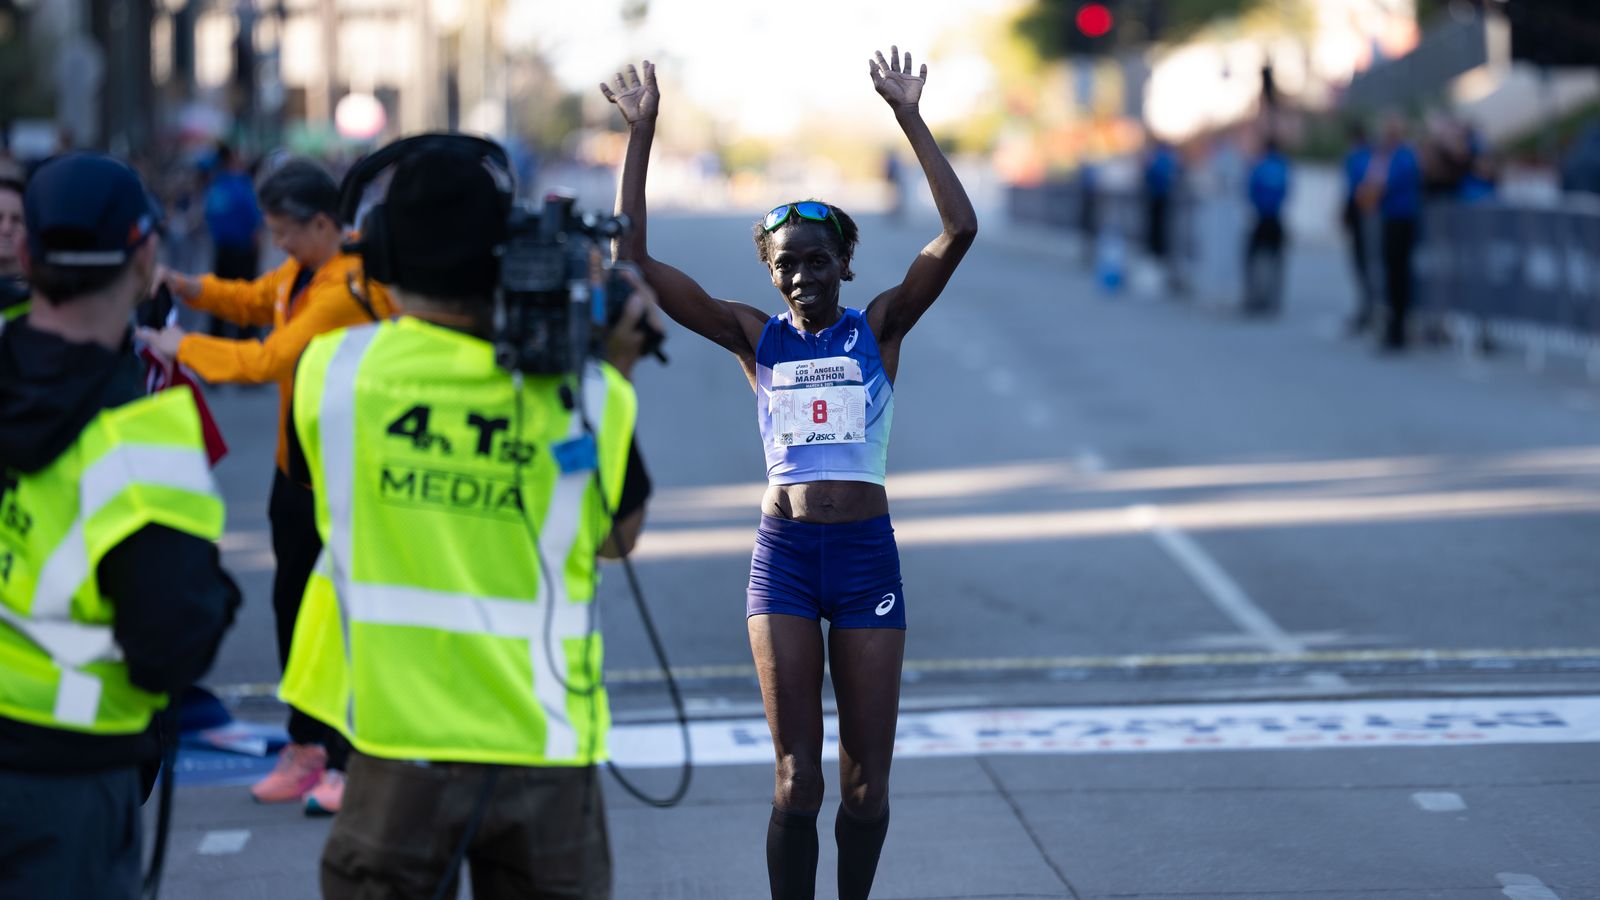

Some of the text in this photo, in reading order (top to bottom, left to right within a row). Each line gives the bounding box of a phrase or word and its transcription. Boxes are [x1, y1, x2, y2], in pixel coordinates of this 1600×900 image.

[814, 366, 845, 374] ANGELES
[796, 373, 844, 382] MARATHON
[812, 400, 828, 424] 8
[815, 433, 836, 441] asics
[381, 466, 525, 513] MEDIA
